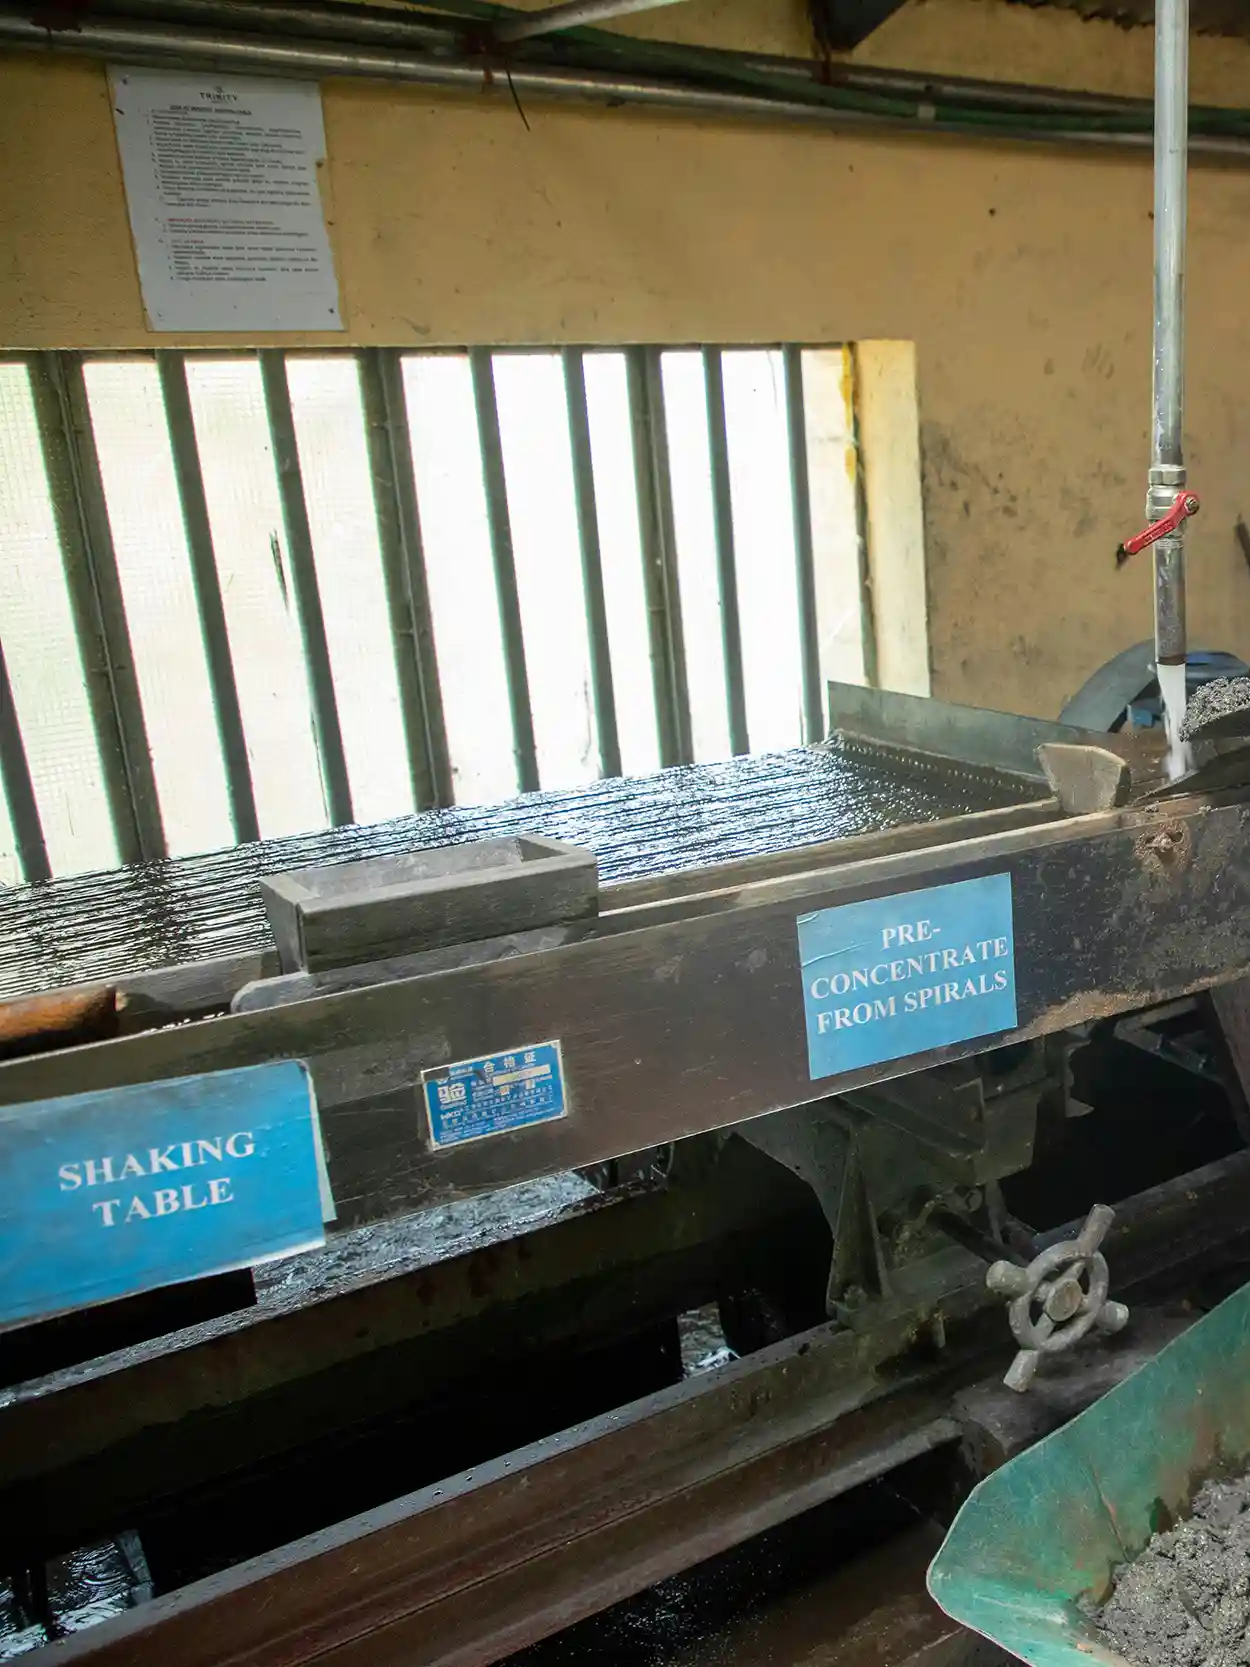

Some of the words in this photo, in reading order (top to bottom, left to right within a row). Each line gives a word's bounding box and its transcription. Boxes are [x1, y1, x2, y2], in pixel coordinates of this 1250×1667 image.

[199, 92, 239, 101] TRINITY
[880, 919, 941, 951] PRE-
[811, 936, 1008, 1000] CONCENTRATE
[816, 996, 898, 1035] FROM
[904, 970, 1008, 1013] SPIRALS
[58, 1131, 256, 1191] SHAKING
[92, 1177, 234, 1227] TABLE
